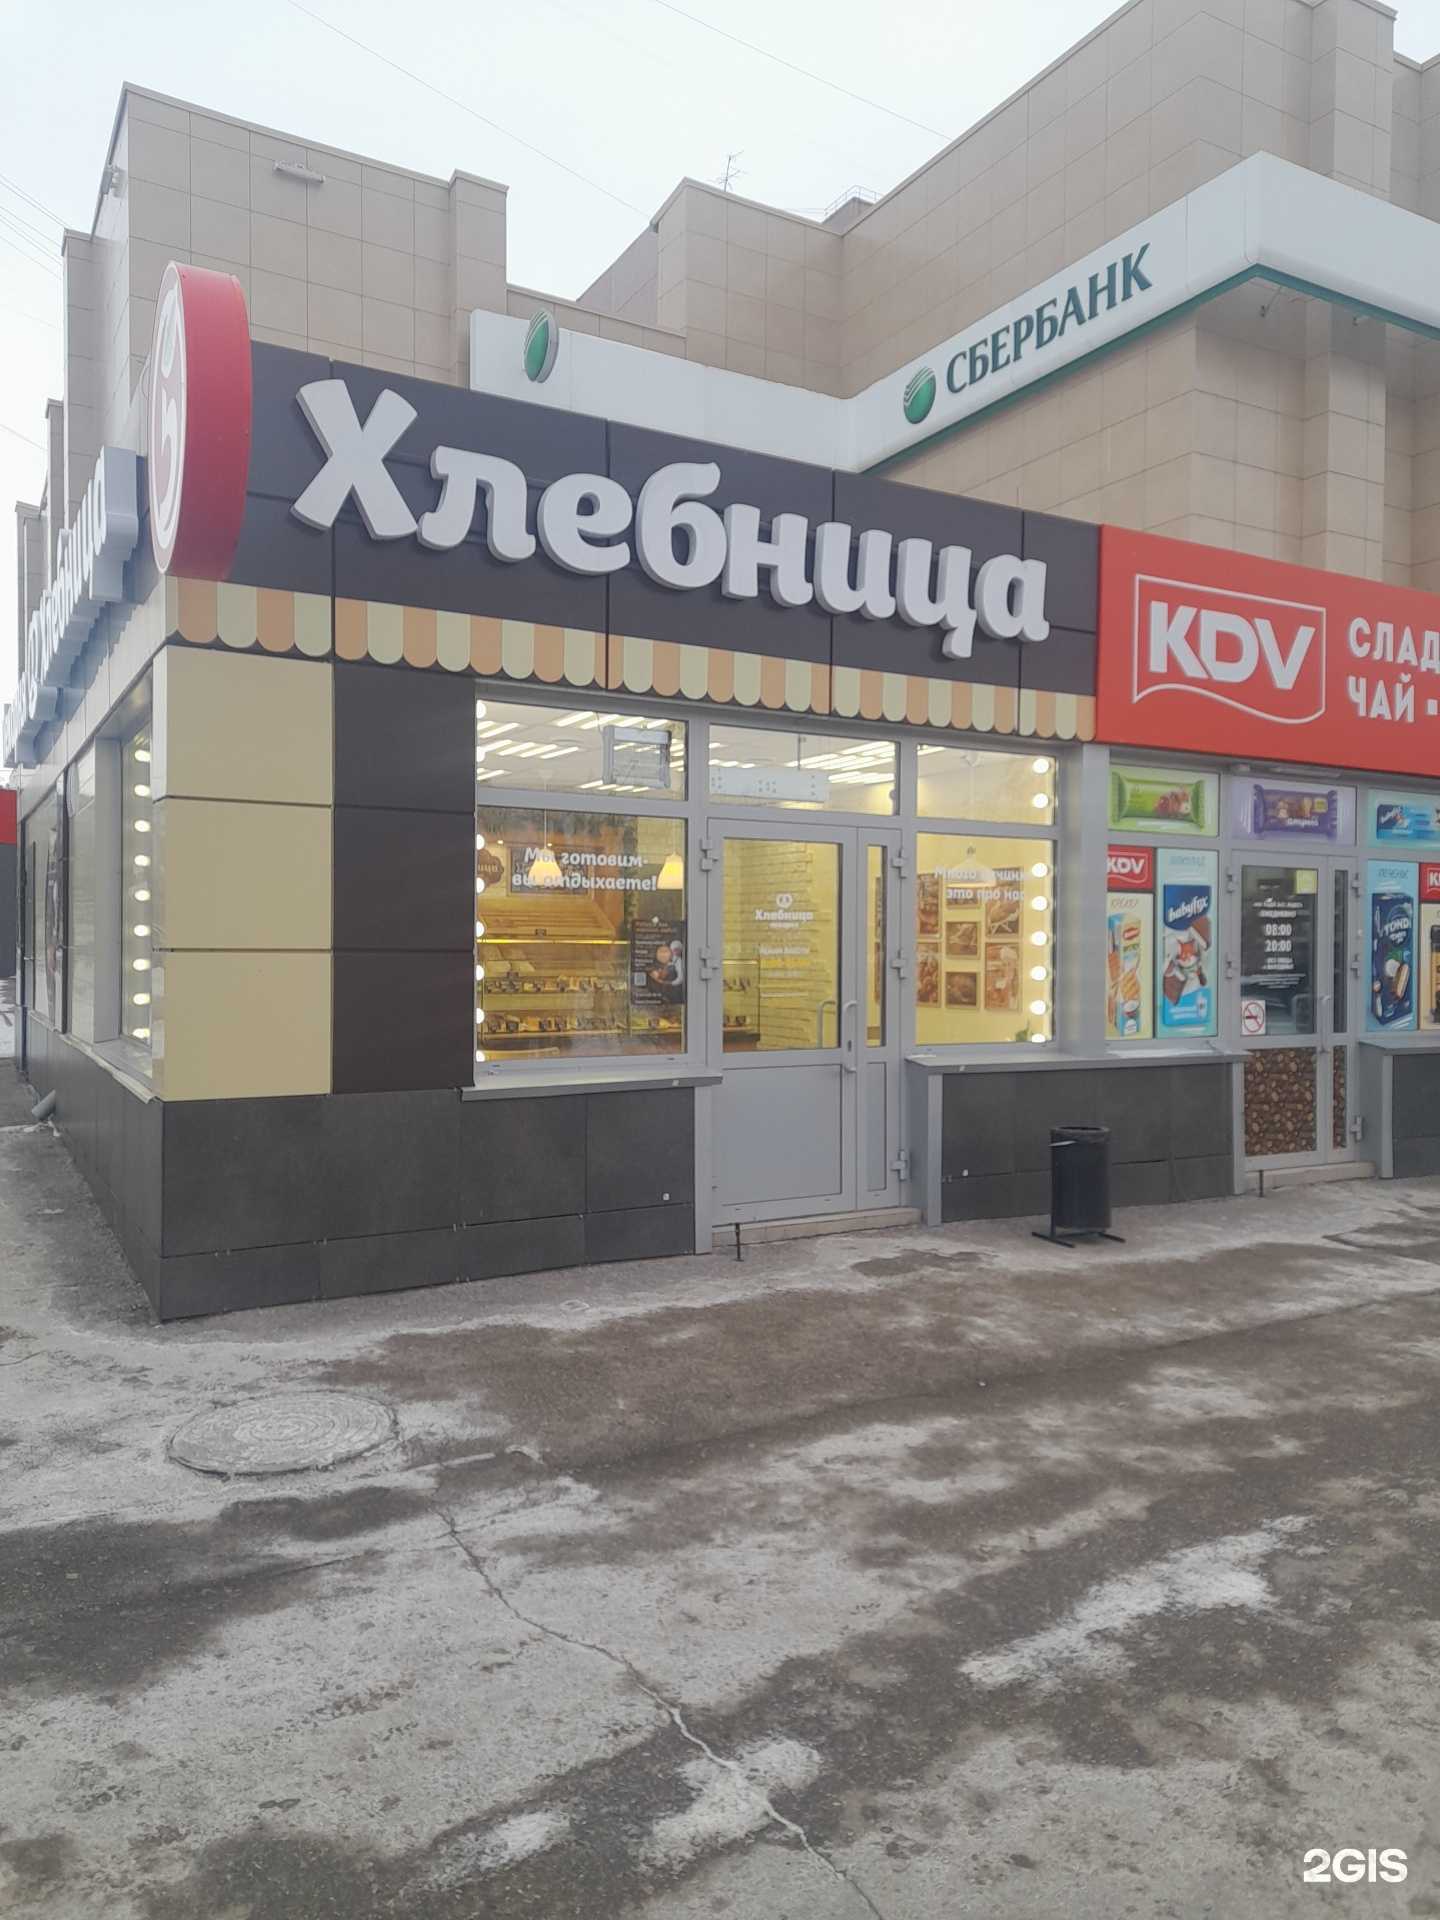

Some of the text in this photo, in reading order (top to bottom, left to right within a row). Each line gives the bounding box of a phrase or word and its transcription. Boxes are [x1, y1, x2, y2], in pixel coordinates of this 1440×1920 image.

[946, 243, 1152, 393] СБЕРБАНК
[292, 379, 1050, 659] Хлебница
[1149, 600, 1315, 690] KDV
[1347, 673, 1415, 722] ЧАЙ
[543, 873, 657, 891] отдыхаете!
[1168, 895, 1209, 923] babyfox
[1264, 924, 1292, 936] 08:00
[1264, 940, 1292, 952] 20:00
